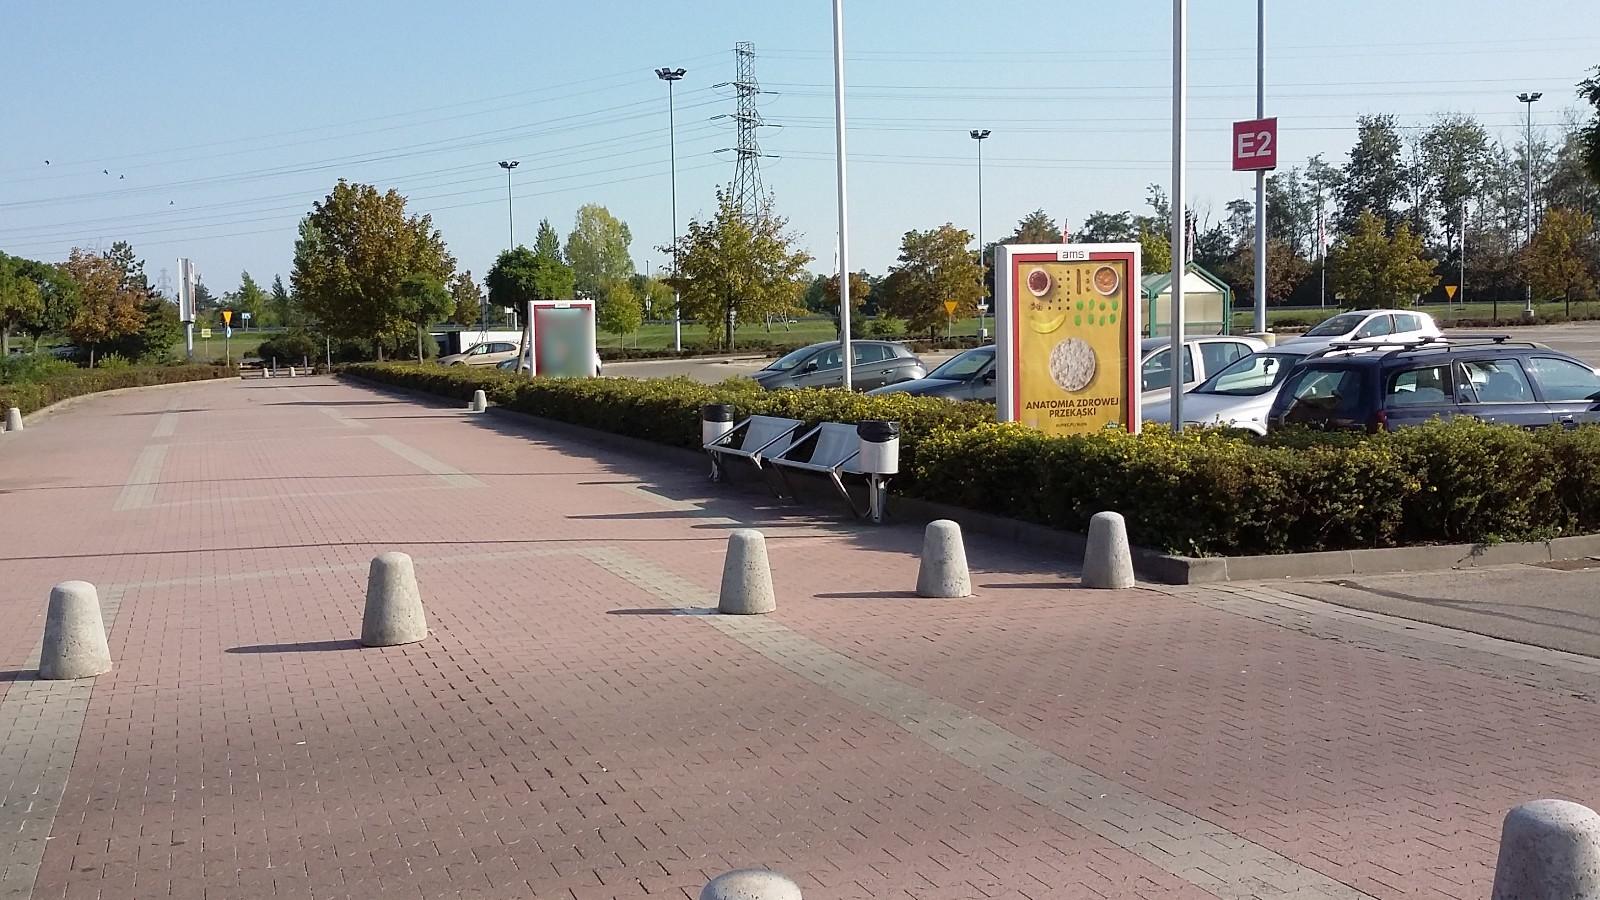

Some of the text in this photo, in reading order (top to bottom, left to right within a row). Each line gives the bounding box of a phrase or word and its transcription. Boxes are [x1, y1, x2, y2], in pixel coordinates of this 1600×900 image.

[1238, 131, 1271, 158] E2
[1062, 250, 1084, 259] ams
[1025, 397, 1119, 409] ANATOMIA ZDROWEJ
[1049, 408, 1096, 419] PRZEKĄSKI
